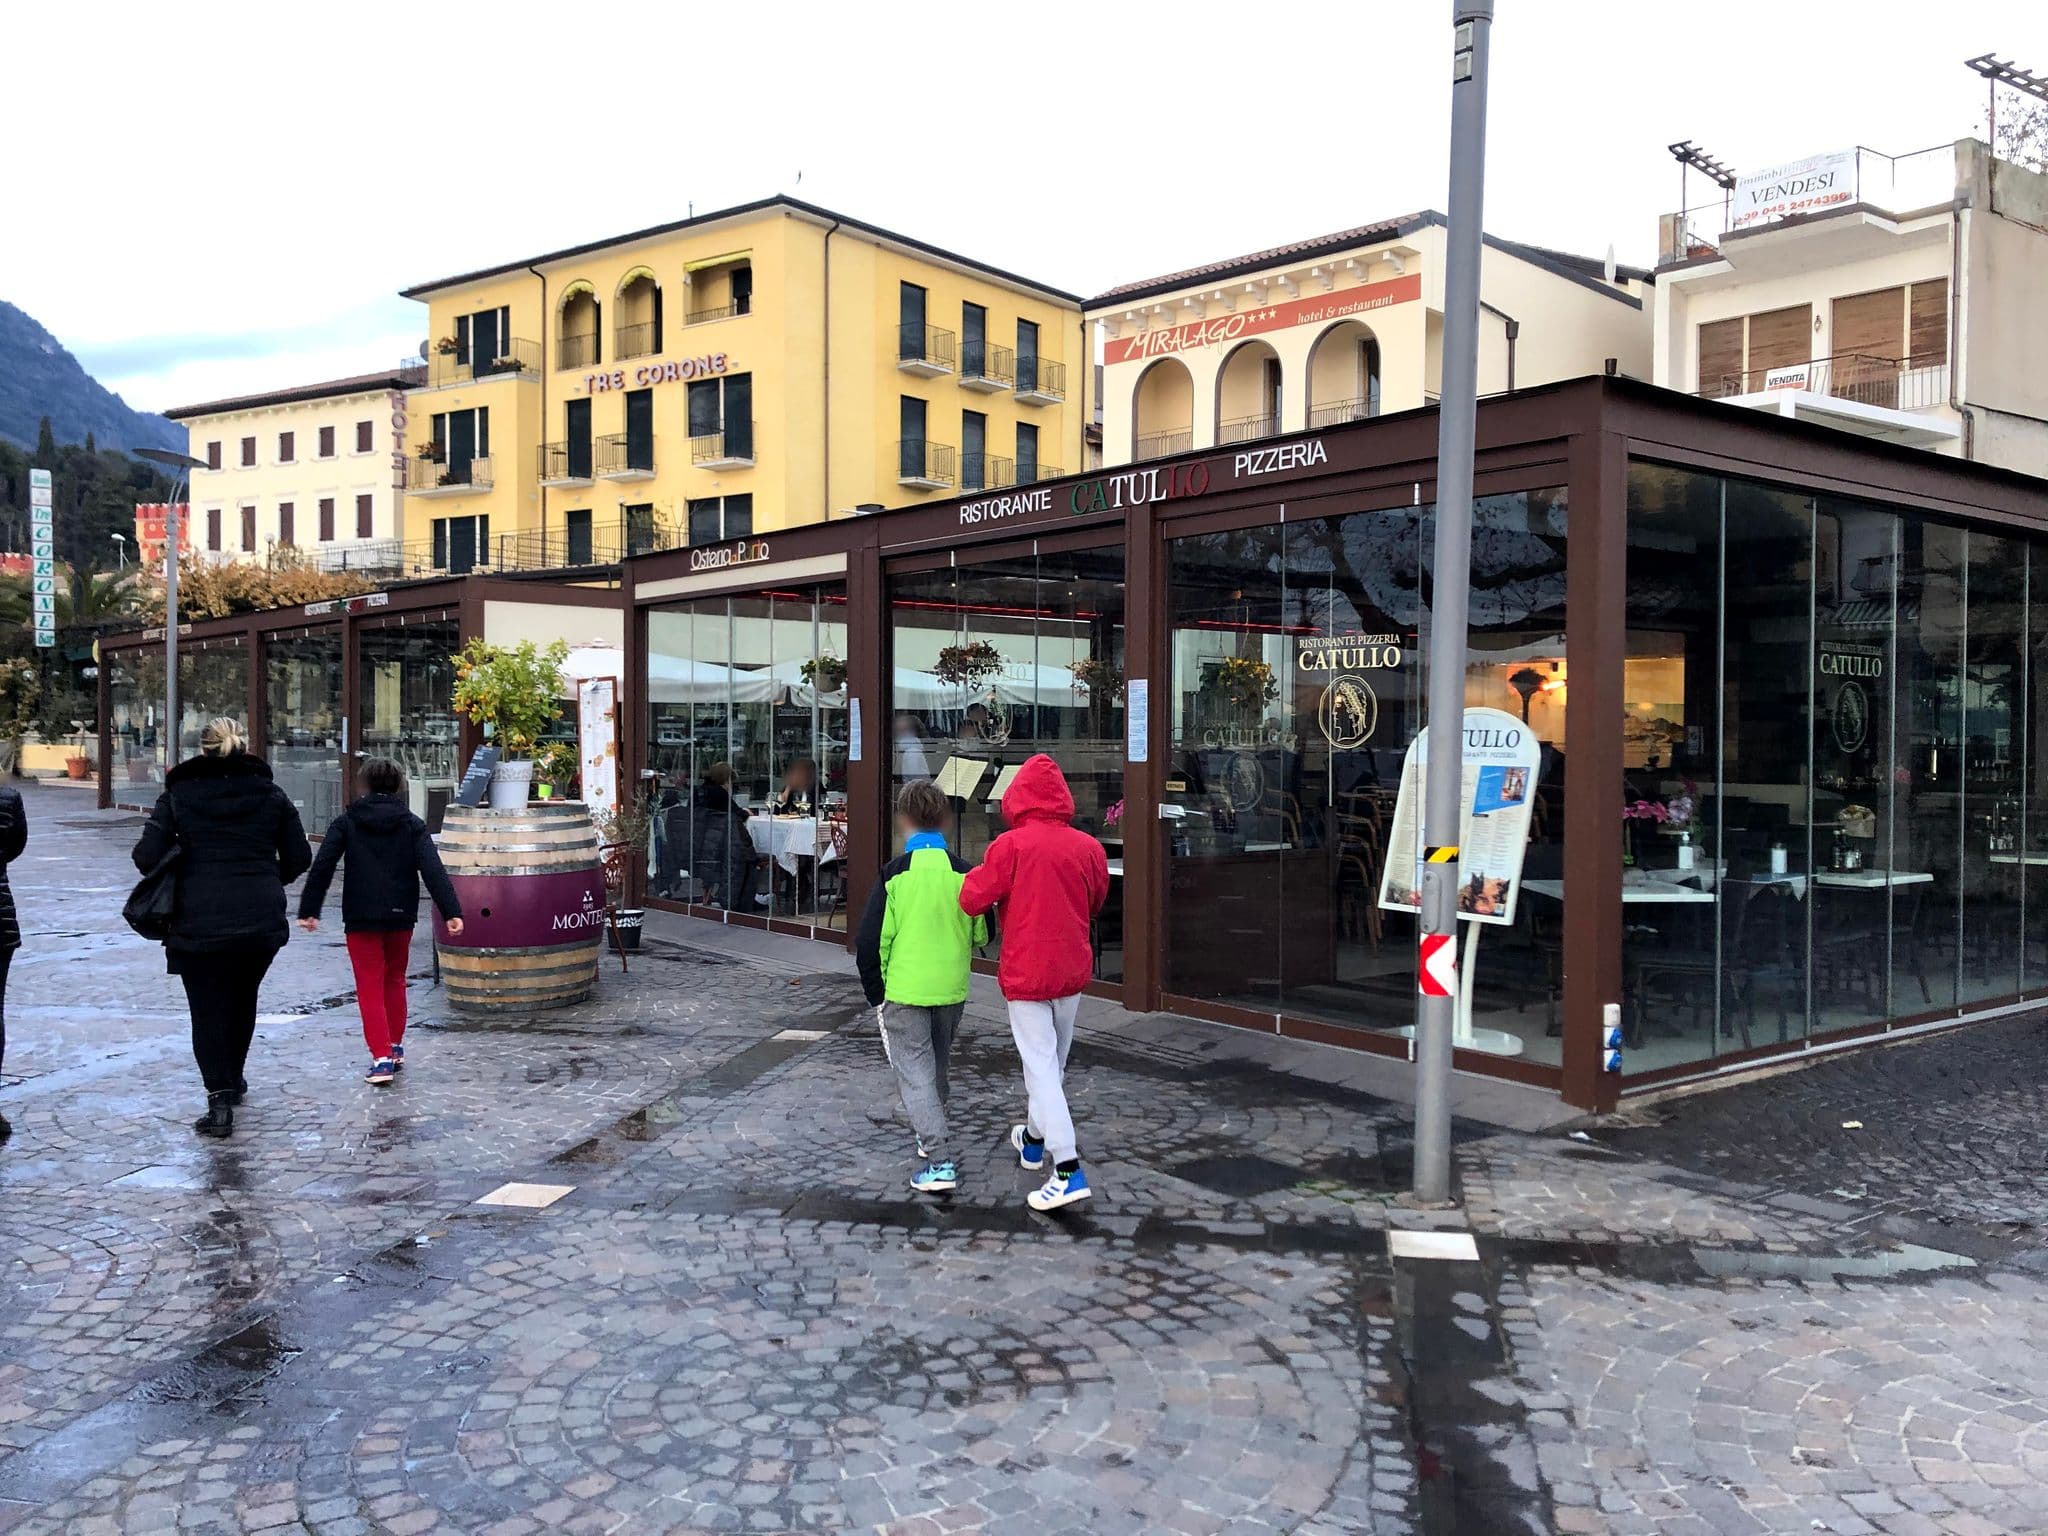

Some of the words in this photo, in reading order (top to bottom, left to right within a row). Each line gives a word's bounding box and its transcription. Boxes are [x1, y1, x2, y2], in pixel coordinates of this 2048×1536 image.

[1751, 171, 1835, 204] VENDESI
[1762, 203, 1786, 215] 045
[1297, 308, 1324, 325] hotel
[1326, 306, 1336, 317] &
[1338, 293, 1394, 315] restaurant
[1123, 314, 1246, 362] MIRALAGO
[584, 369, 625, 394] TRE
[634, 351, 727, 387] CORONE
[1768, 373, 1805, 386] VENDITA
[959, 489, 1052, 525] RISTORANTE
[1070, 458, 1210, 516] CATULLO
[1235, 440, 1328, 478] PIZZERIA
[737, 540, 770, 563] Prto
[38, 633, 53, 645] Bar
[1299, 635, 1356, 648] RISTORANTE
[1358, 634, 1401, 645] PIZZERIA
[1299, 646, 1401, 671] CATULLO
[1820, 653, 1882, 677] CATULLO
